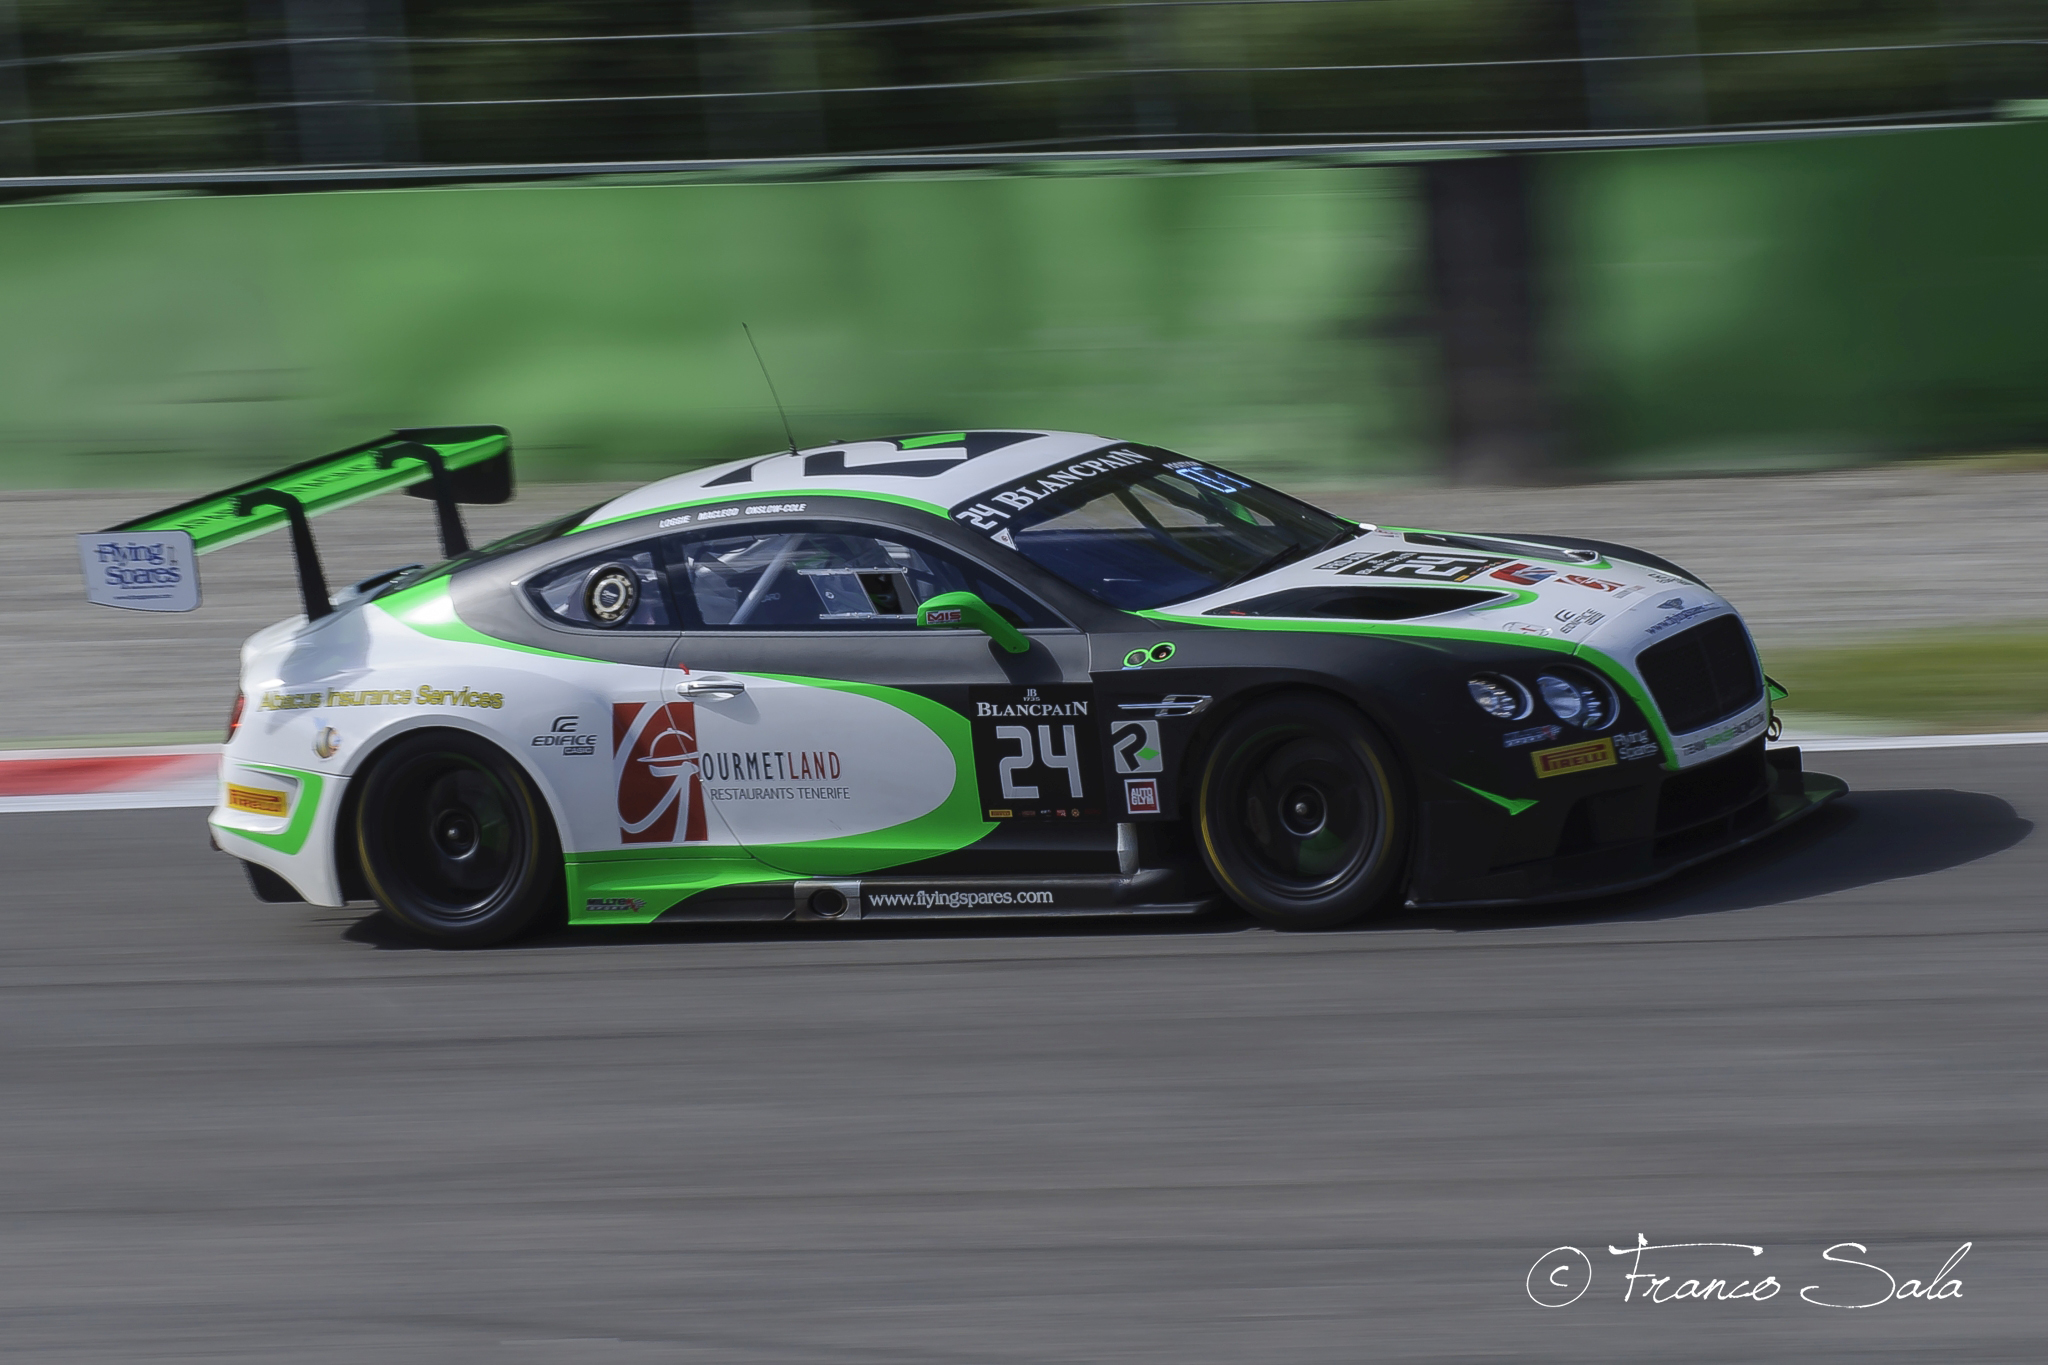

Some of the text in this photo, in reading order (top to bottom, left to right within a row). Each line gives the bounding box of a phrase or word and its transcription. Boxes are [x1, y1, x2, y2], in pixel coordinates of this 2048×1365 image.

[956, 449, 1154, 531] 24 BLANCPAIN
[697, 507, 740, 521] MACLEOD
[745, 503, 807, 515] ONSLOW-COLE
[94, 543, 165, 566] Flying
[1384, 554, 1491, 578] 24
[106, 566, 182, 589] Spares
[927, 611, 961, 621] MIS
[325, 687, 413, 707] Insurance
[415, 685, 506, 710] Services
[976, 701, 1088, 716] BLANCPAIN
[531, 734, 598, 747] EDIFICE
[996, 725, 1083, 799] 24
[1540, 743, 1608, 772] PIRELLI
[229, 788, 282, 812] PIRELLI
[711, 787, 850, 801] RESTAURANTS TENERIFE
[1131, 787, 1153, 797] AUTO
[868, 890, 1054, 909] www.flyingspares.com
